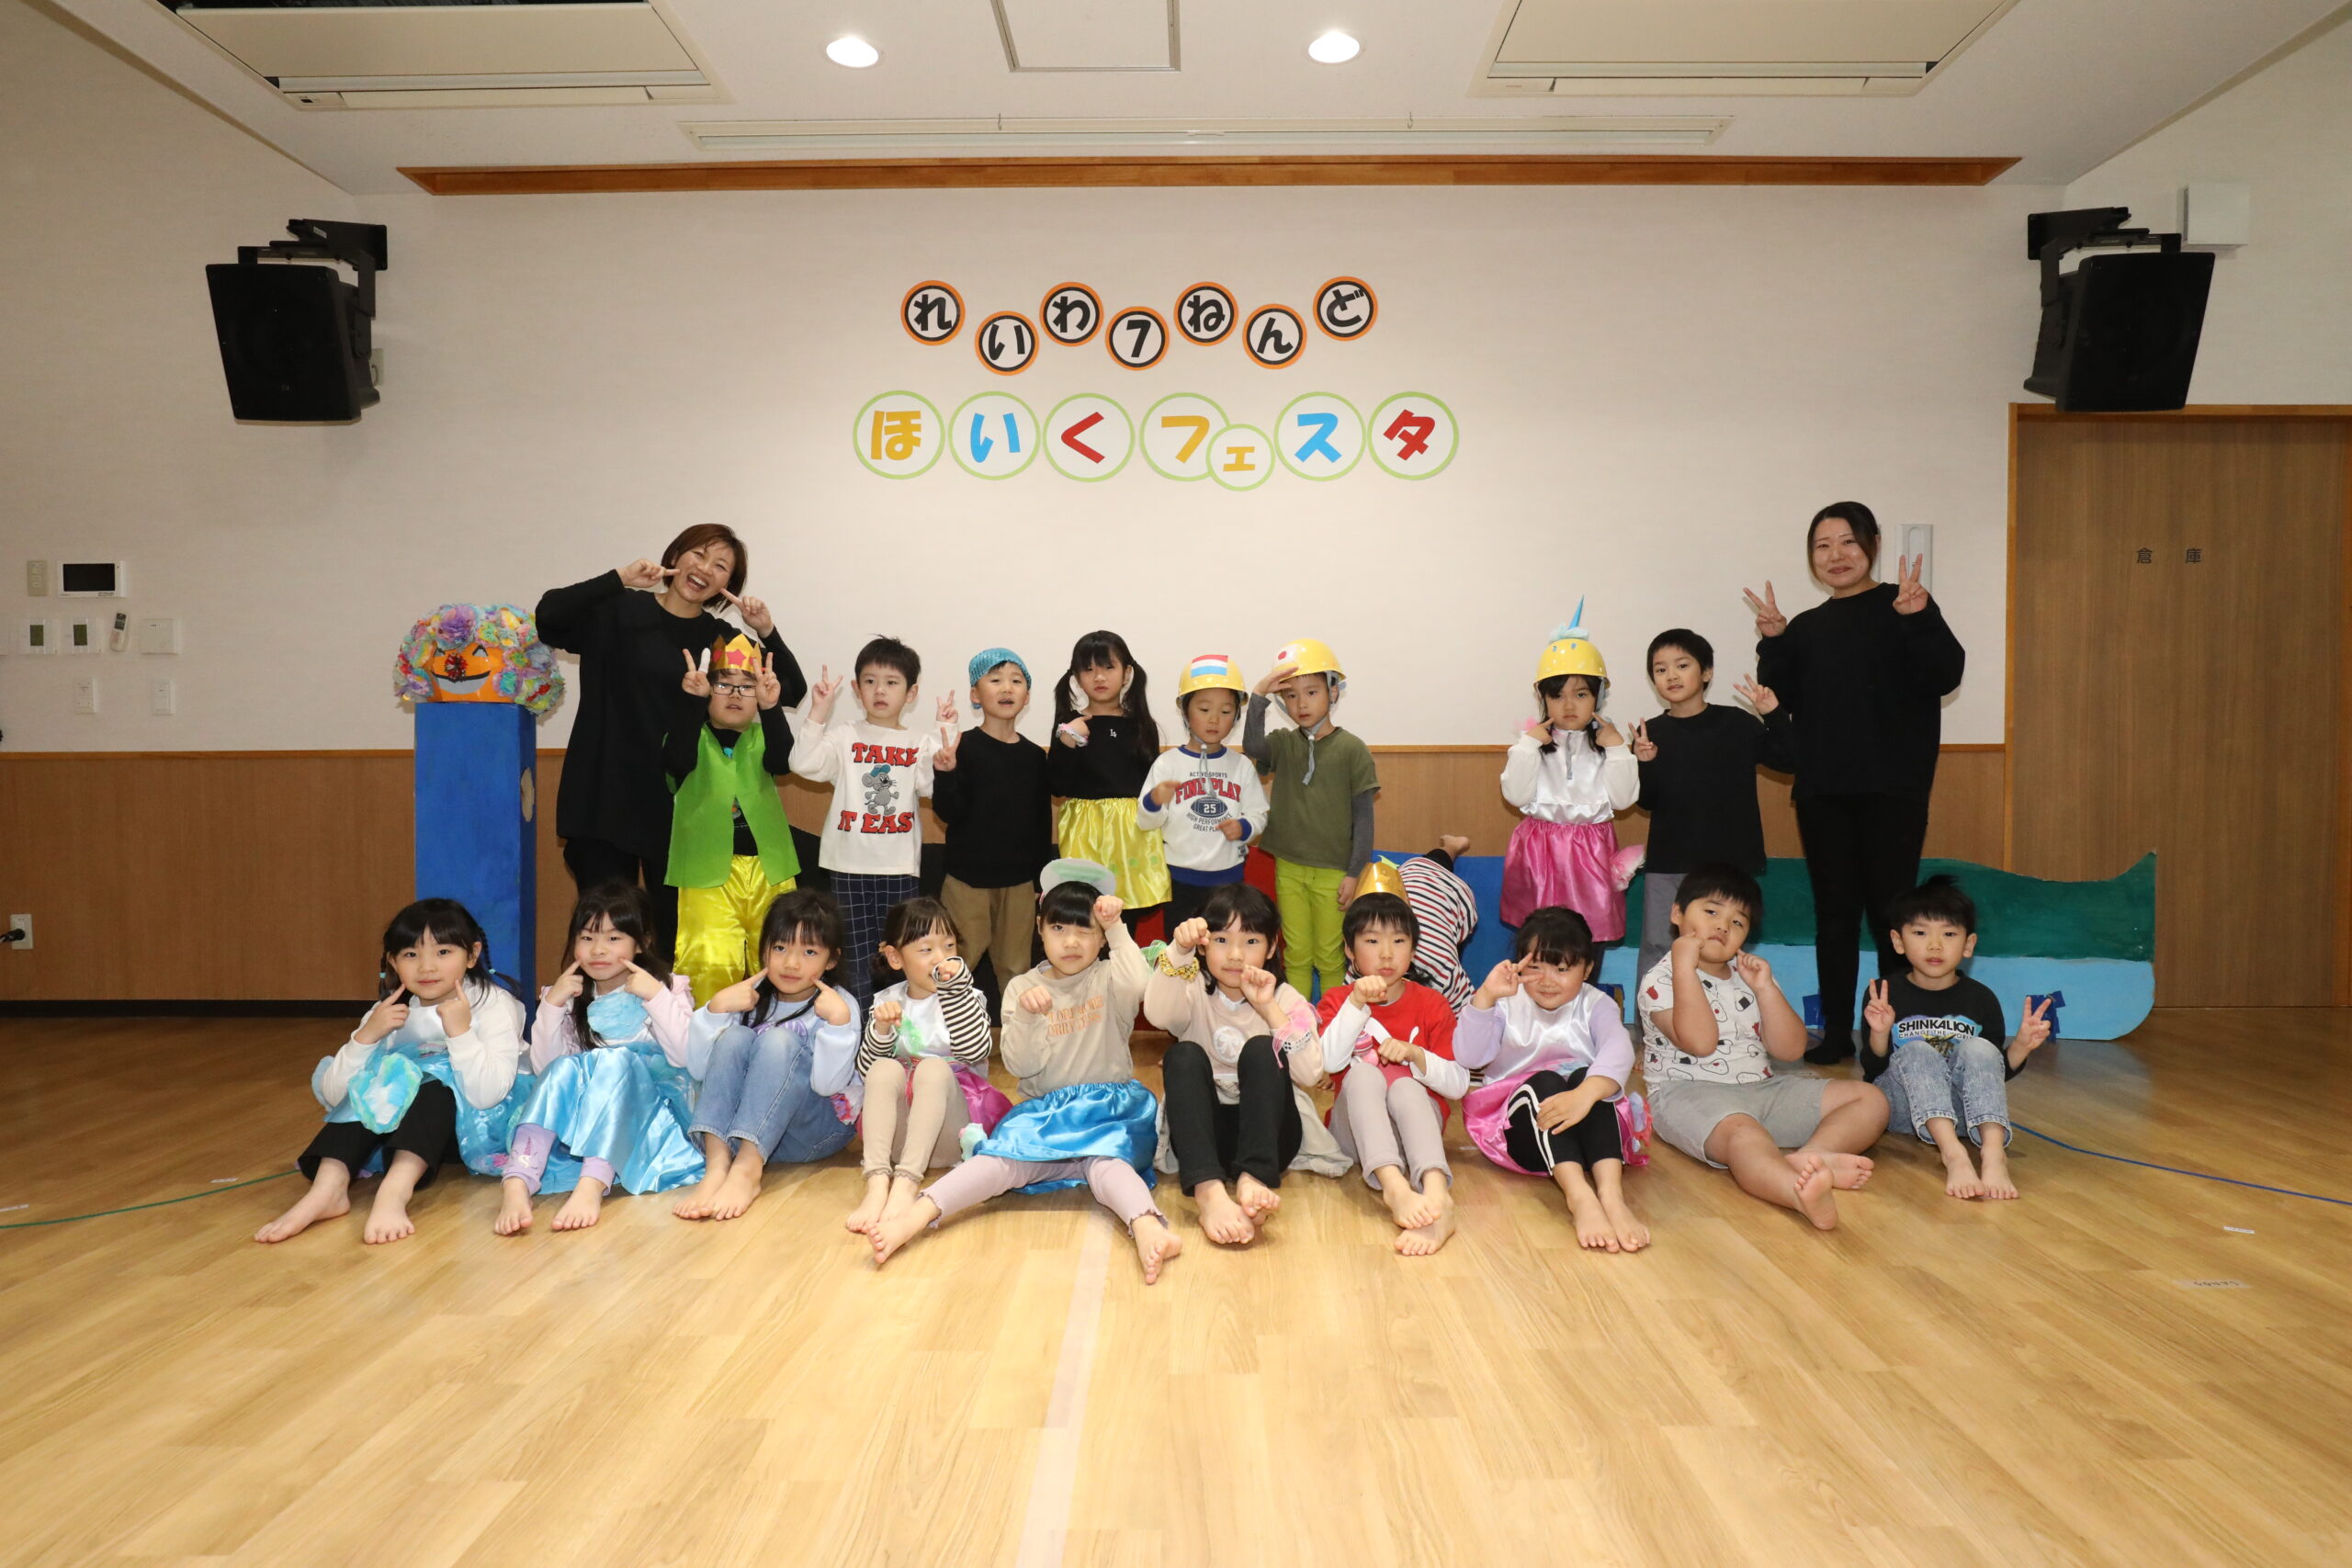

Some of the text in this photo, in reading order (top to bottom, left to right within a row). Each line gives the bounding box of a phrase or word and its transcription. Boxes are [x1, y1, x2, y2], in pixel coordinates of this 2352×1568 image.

[869, 407, 1437, 473] ほいくフェスタ
[2136, 547, 2202, 565] 倉庫
[852, 741, 920, 767] TAKE
[1209, 777, 1241, 803] PLAY
[837, 809, 915, 834] IT EAS
[1204, 804, 1216, 814] 25
[1898, 1019, 1974, 1036] SHINKALION
